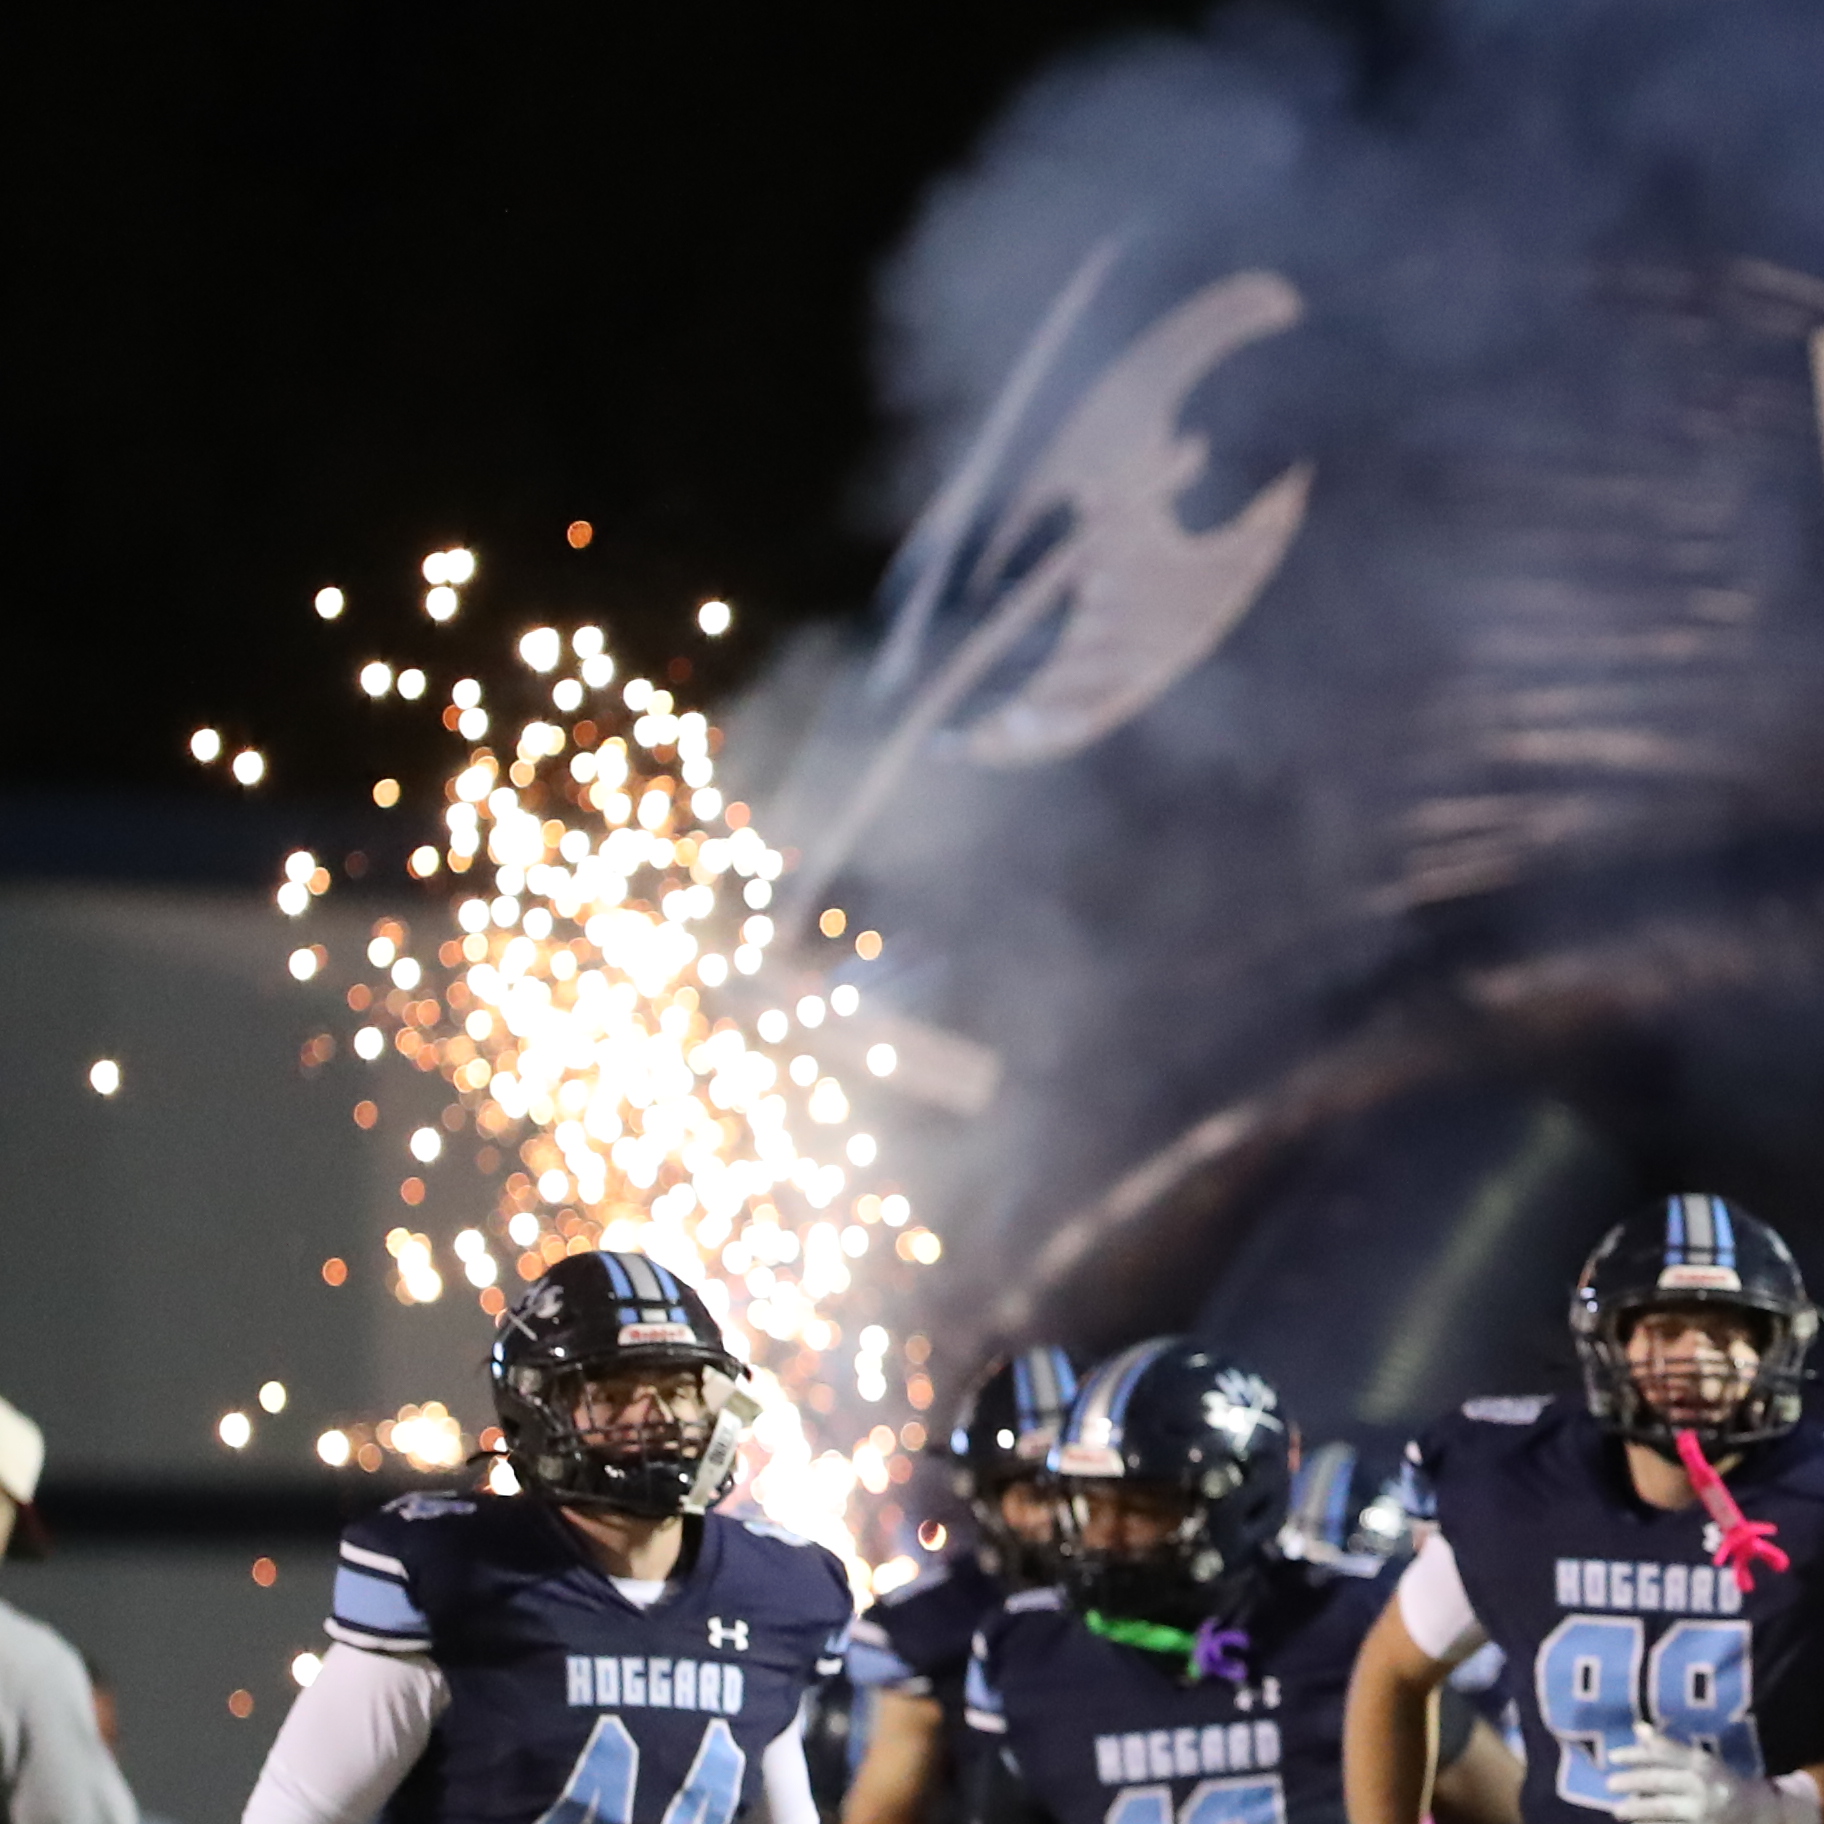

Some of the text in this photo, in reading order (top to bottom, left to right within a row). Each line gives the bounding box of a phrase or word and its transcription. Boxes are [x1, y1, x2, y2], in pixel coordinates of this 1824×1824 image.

[1555, 1556, 1744, 1614] HOGGARD
[565, 1655, 744, 1715] HOGGARD
[1094, 1718, 1281, 1785] HOGGARD
